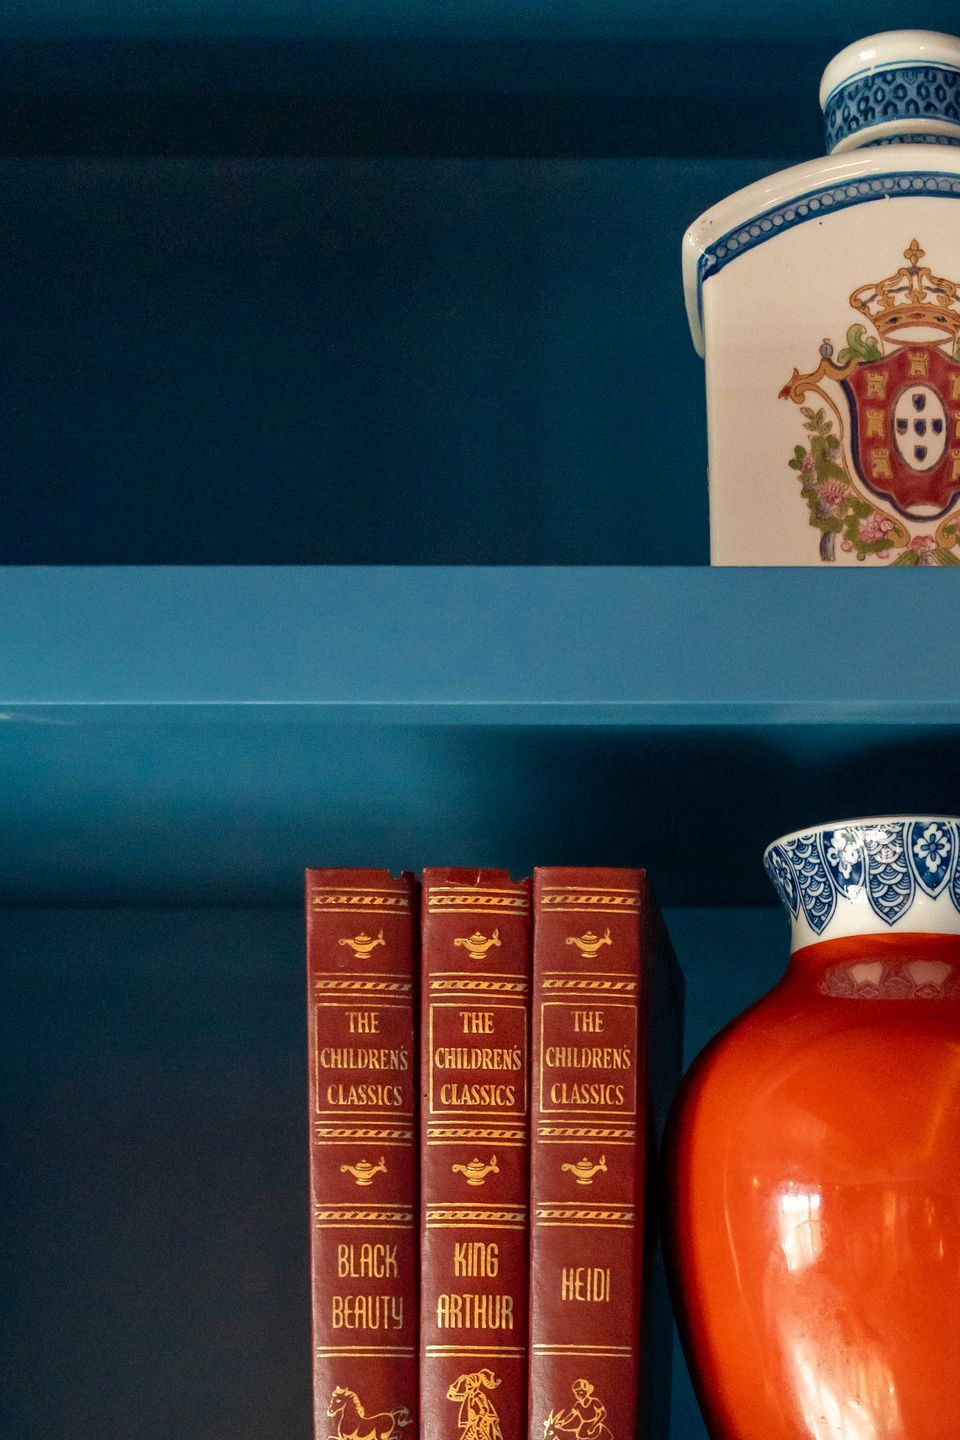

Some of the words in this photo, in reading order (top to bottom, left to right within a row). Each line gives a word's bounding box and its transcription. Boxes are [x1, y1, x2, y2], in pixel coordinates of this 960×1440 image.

[346, 1012, 379, 1033] THE
[459, 1012, 494, 1033] THE
[571, 1011, 604, 1032] THE
[327, 1084, 402, 1106] CLASSICS
[440, 1084, 515, 1106] CLASSICS
[551, 1083, 624, 1105] CLASSICS
[338, 1244, 399, 1278] BLACK
[454, 1242, 499, 1277] KING
[561, 1268, 611, 1301] HEIDI
[332, 1296, 403, 1330] BEAUTY
[436, 1294, 514, 1330] ARTHUR
